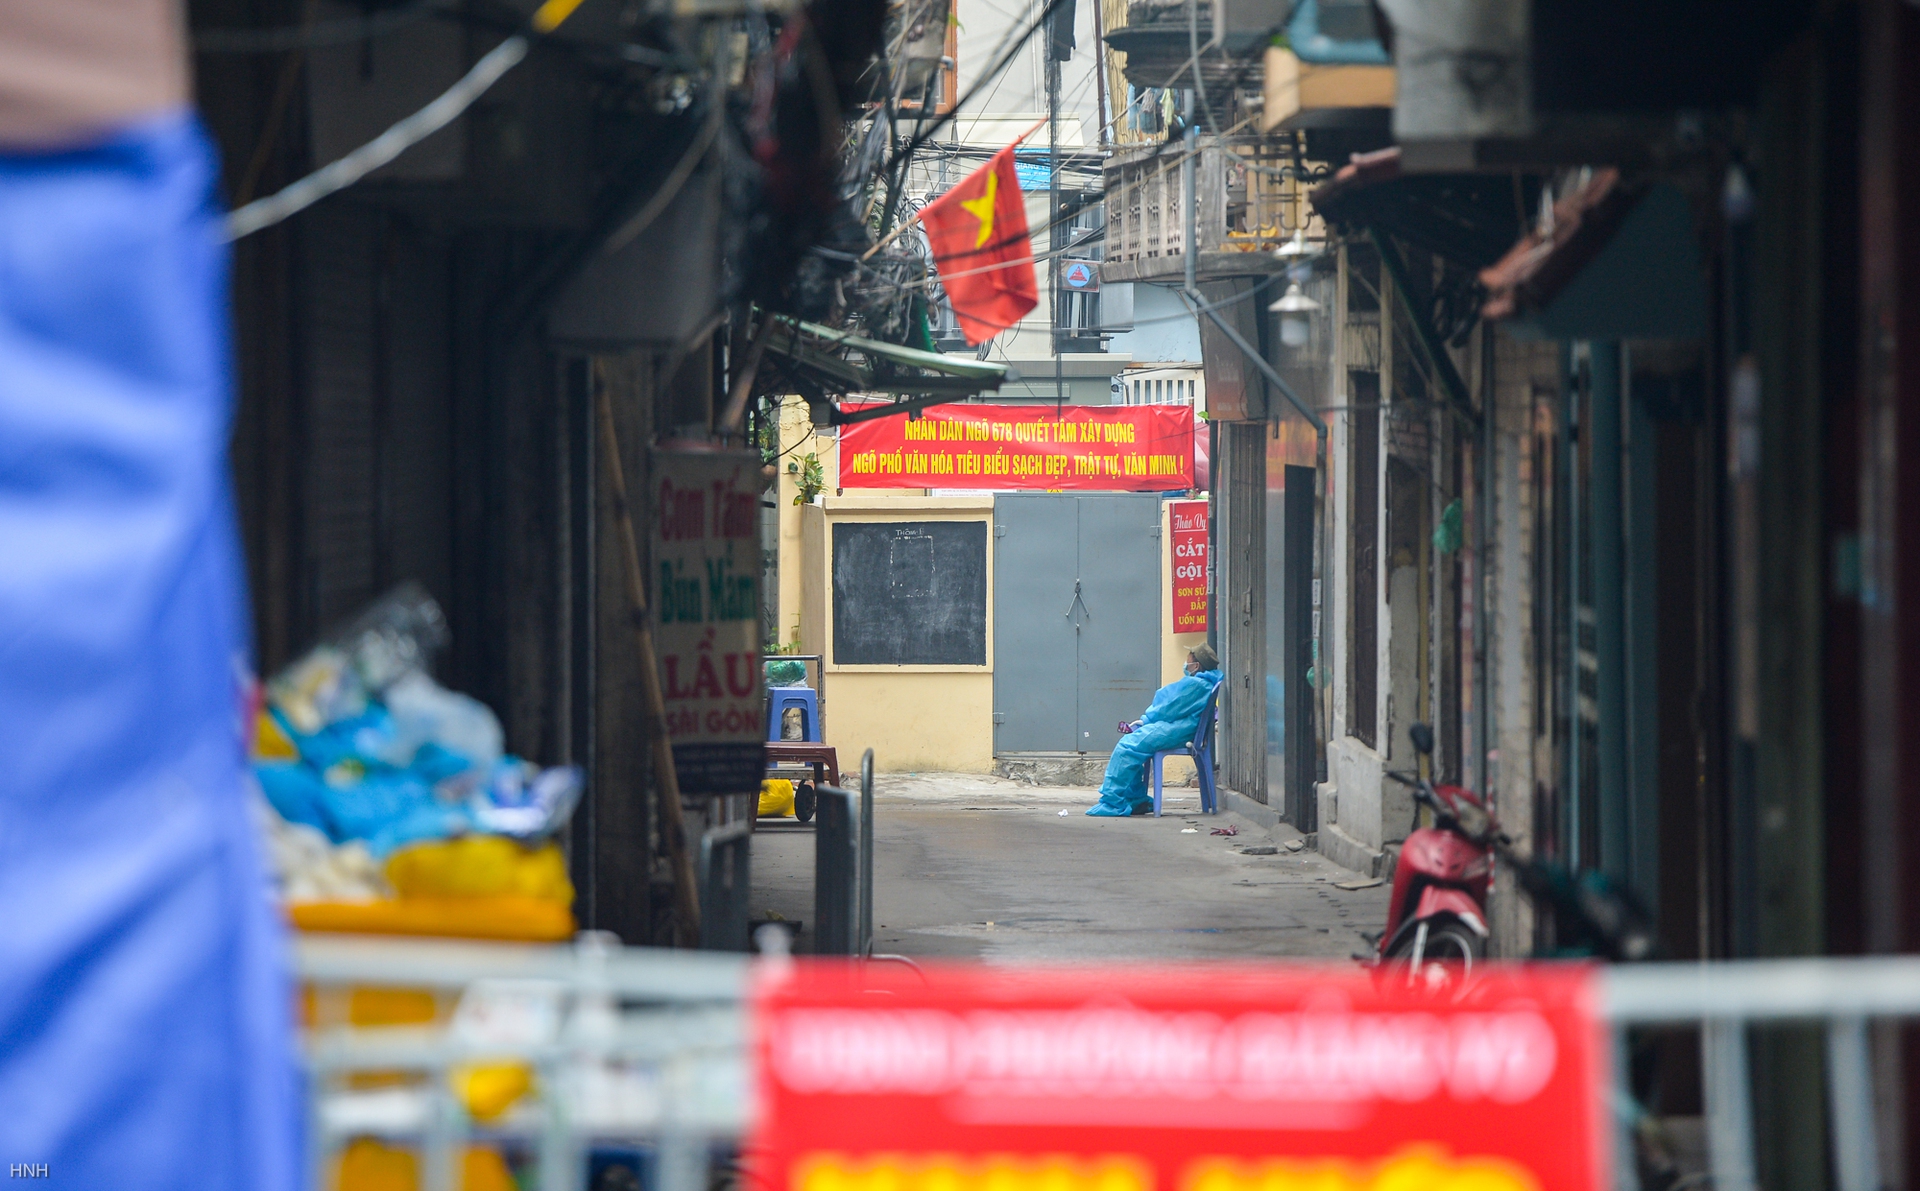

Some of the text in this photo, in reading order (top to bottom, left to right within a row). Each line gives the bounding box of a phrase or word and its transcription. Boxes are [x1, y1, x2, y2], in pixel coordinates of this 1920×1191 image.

[905, 416, 1135, 447] NHÂN DÂN NGÕ 678 QUYẾT TÂM XÂY DỰNG
[853, 446, 1184, 480] NGÕ PHỐ VĂN HÓA TIÊU BIỂU SẠCH ĐẸP, TRẬT TỰ, VĂN MINH !
[1176, 537, 1205, 557] CẮT
[1176, 562, 1203, 581] GỘI
[1190, 597, 1207, 610] ĐẮP
[1178, 612, 1195, 625] UỐN
